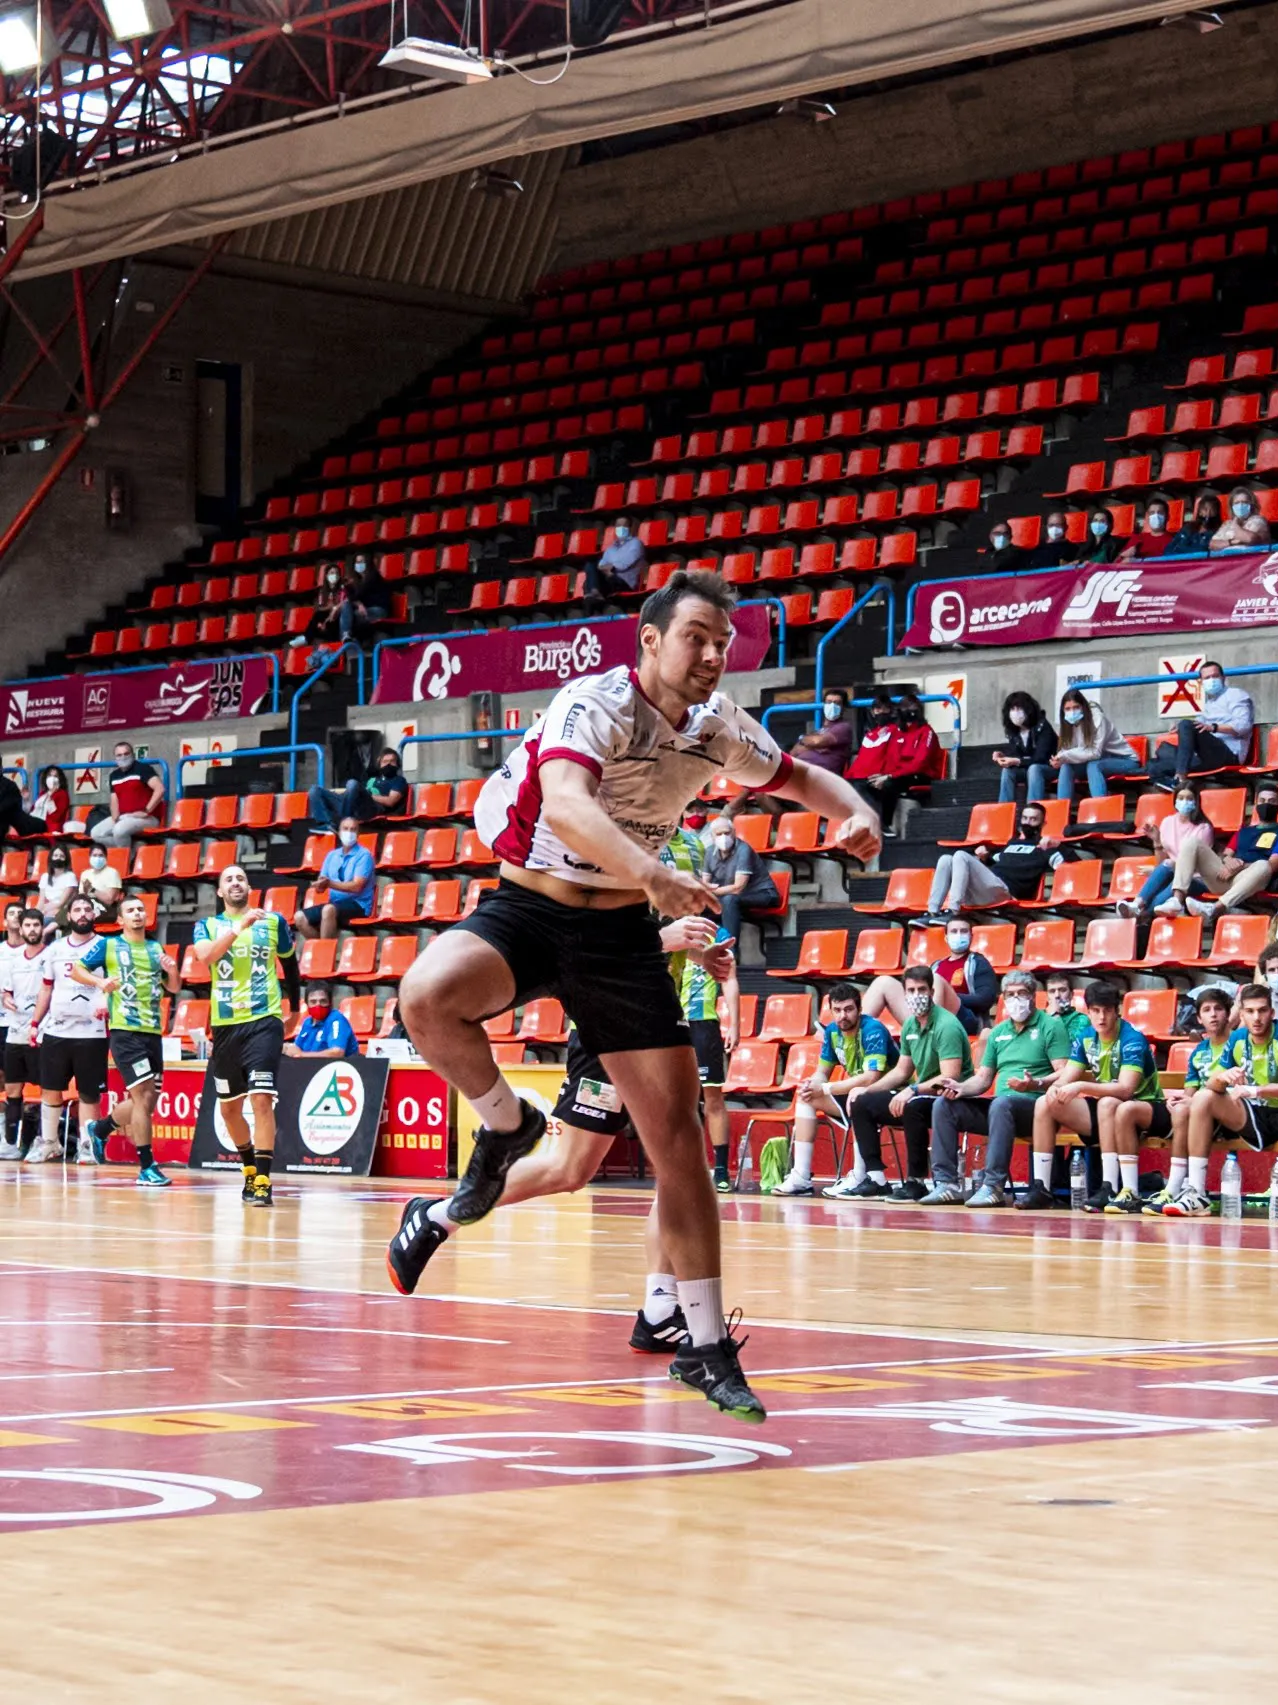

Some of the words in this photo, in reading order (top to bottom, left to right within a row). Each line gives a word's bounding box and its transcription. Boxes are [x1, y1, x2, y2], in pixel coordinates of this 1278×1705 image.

[1234, 597, 1269, 609] JAVIER
[523, 627, 602, 679] Burgos
[27, 696, 65, 707] NUEVE
[87, 688, 107, 705] AC
[571, 1104, 608, 1120] LEGEA
